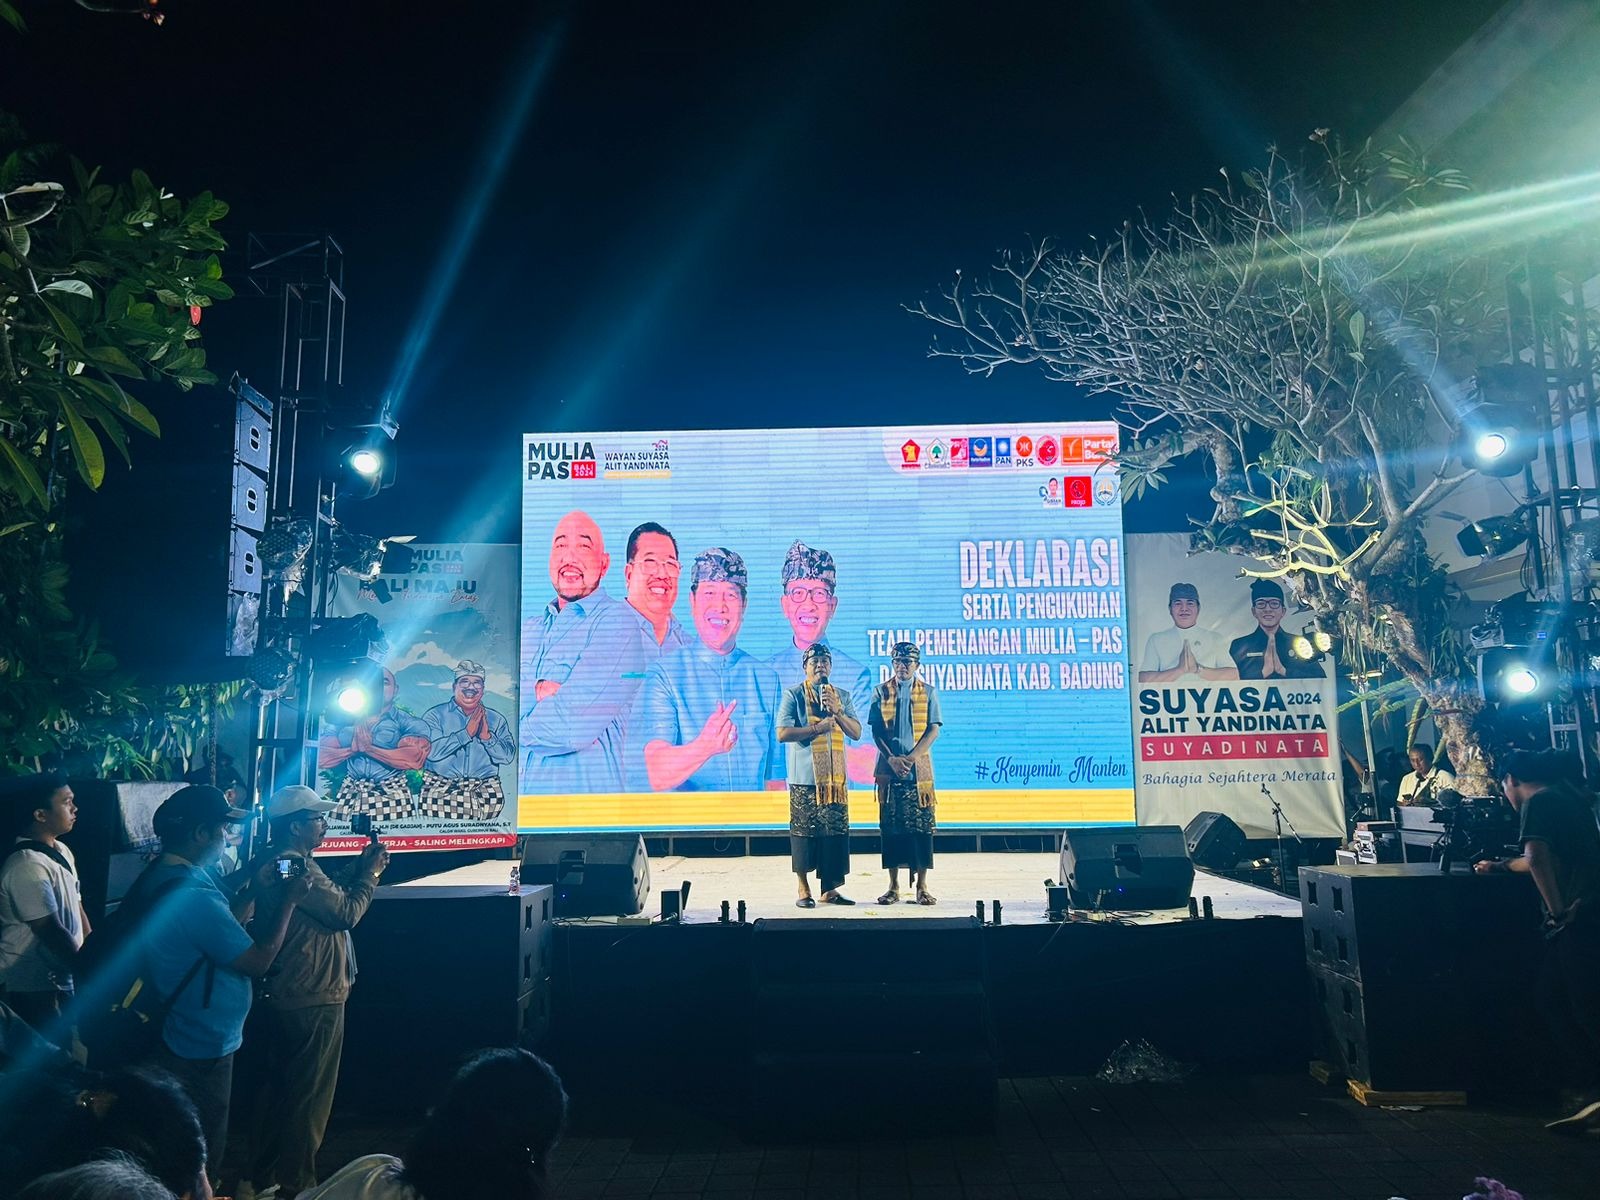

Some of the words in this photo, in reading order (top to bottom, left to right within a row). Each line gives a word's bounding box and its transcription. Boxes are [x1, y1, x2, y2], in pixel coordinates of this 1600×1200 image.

[528, 442, 595, 460] MULIA
[605, 452, 636, 460] WAYAN
[638, 452, 670, 460] SUYASA
[996, 456, 1012, 464] PAN
[528, 462, 569, 480] PAS
[605, 462, 621, 470] ALIT
[623, 462, 670, 470] YANDINATA
[1016, 458, 1034, 466] PKS
[410, 550, 463, 561] MULIA
[960, 538, 1120, 588] DEKLARASI
[410, 563, 442, 573] PAS
[359, 579, 408, 592] BLI
[963, 593, 1011, 620] SERTA
[1016, 591, 1120, 618] PENGUKUHAN
[915, 628, 1021, 656] PEMENANGAN
[1026, 627, 1075, 654] MULIA
[1092, 626, 1122, 654] PAS
[1017, 663, 1055, 690] KAB.
[1061, 662, 1124, 689] BADUNG
[1139, 686, 1287, 715] SUYASA
[1287, 693, 1322, 705] 2024
[1141, 717, 1189, 734] ALIT
[1196, 714, 1326, 733] YANDINATA
[1146, 739, 1324, 756] SUYADINATA
[1069, 755, 1127, 783] Manten
[1143, 771, 1202, 788] Bahagia
[1208, 769, 1276, 787] Sejahtera
[1282, 768, 1336, 782] Merata
[448, 837, 506, 845] MELENGKAPI
